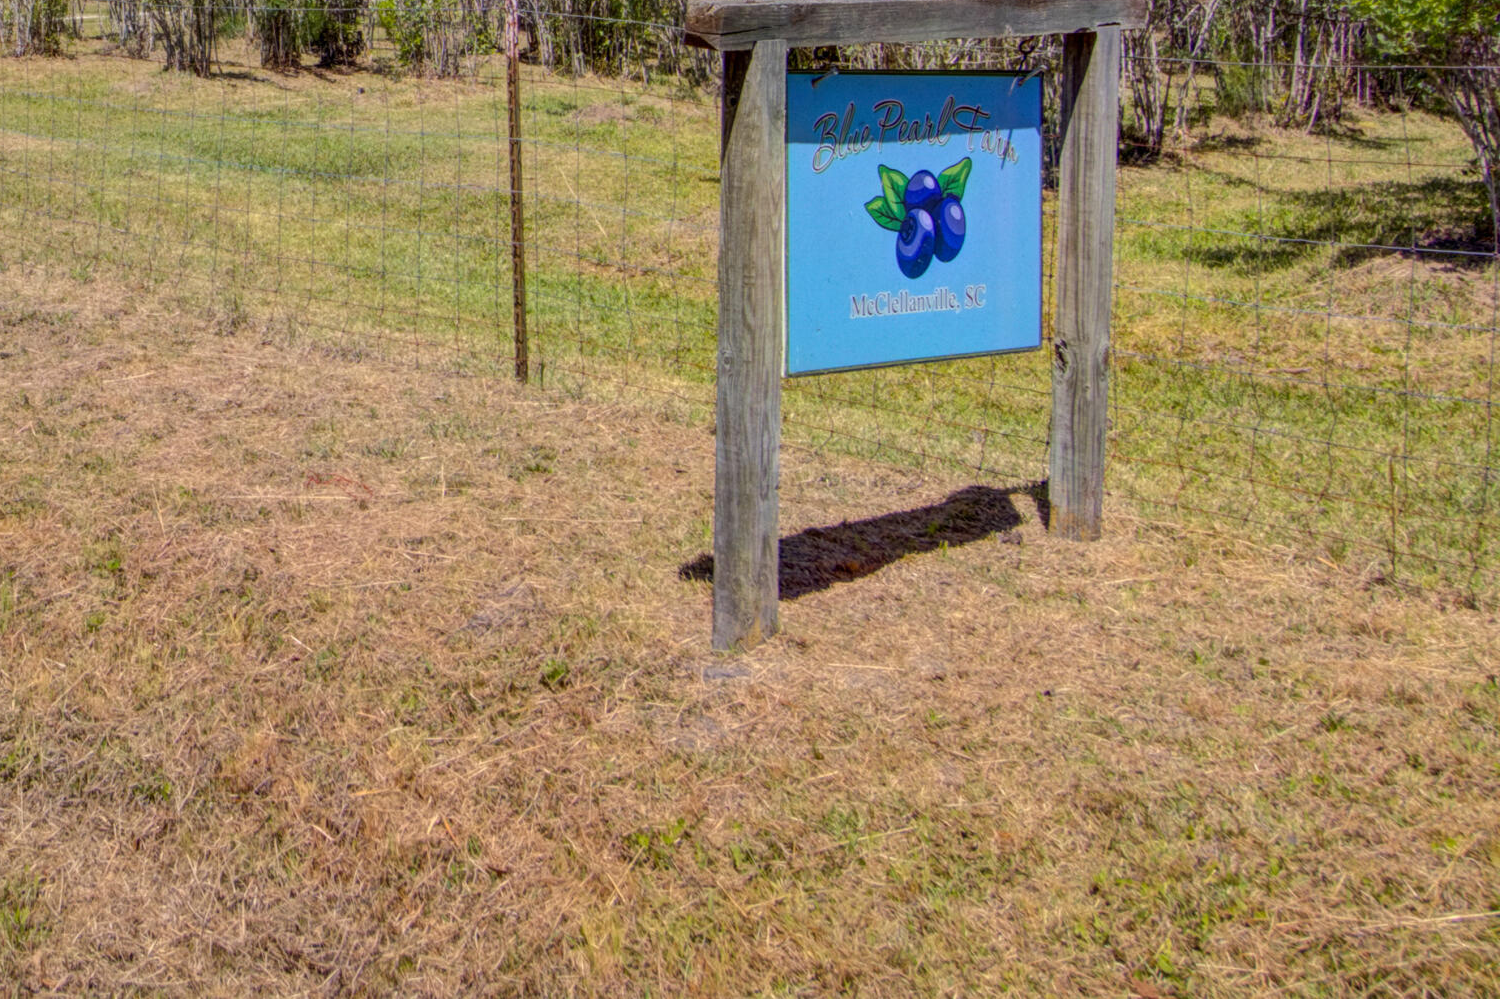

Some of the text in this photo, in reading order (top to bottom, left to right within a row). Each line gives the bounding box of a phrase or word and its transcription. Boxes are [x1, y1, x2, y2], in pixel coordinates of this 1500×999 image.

[812, 95, 1018, 174] Blue Pearl Farm
[850, 283, 986, 319] McClellanville, SC
